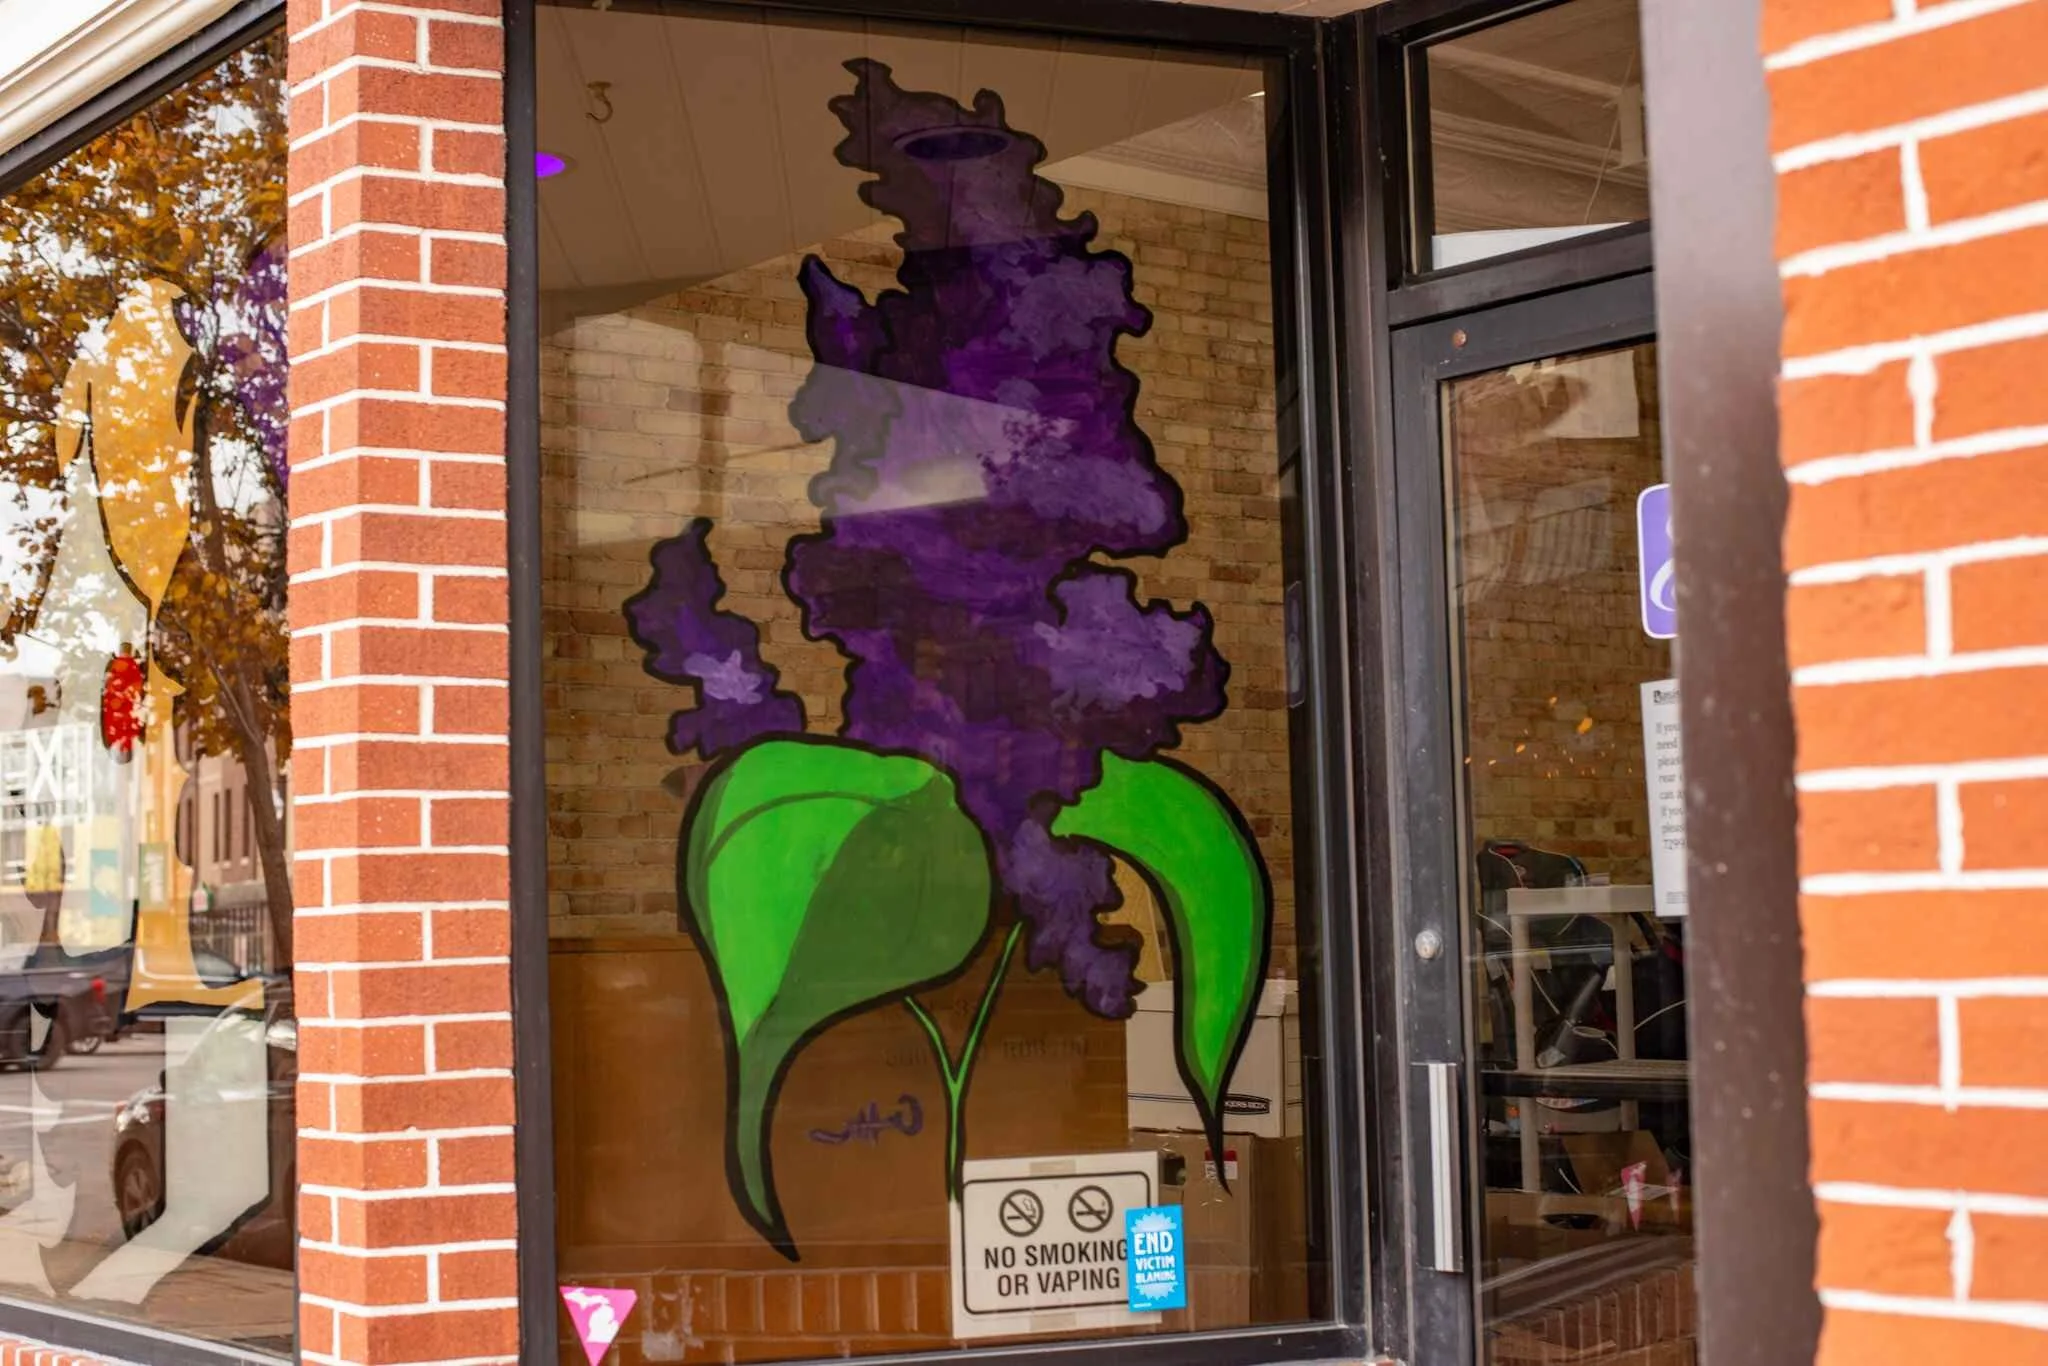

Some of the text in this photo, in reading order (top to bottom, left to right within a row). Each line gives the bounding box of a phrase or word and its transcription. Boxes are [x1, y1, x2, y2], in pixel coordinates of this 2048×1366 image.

[984, 1239, 1128, 1270] NO SMOKING
[1134, 1231, 1174, 1255] END
[1135, 1255, 1176, 1270] VICTIM
[997, 1267, 1120, 1297] OR VAPING
[1135, 1270, 1176, 1284] BLAMING
